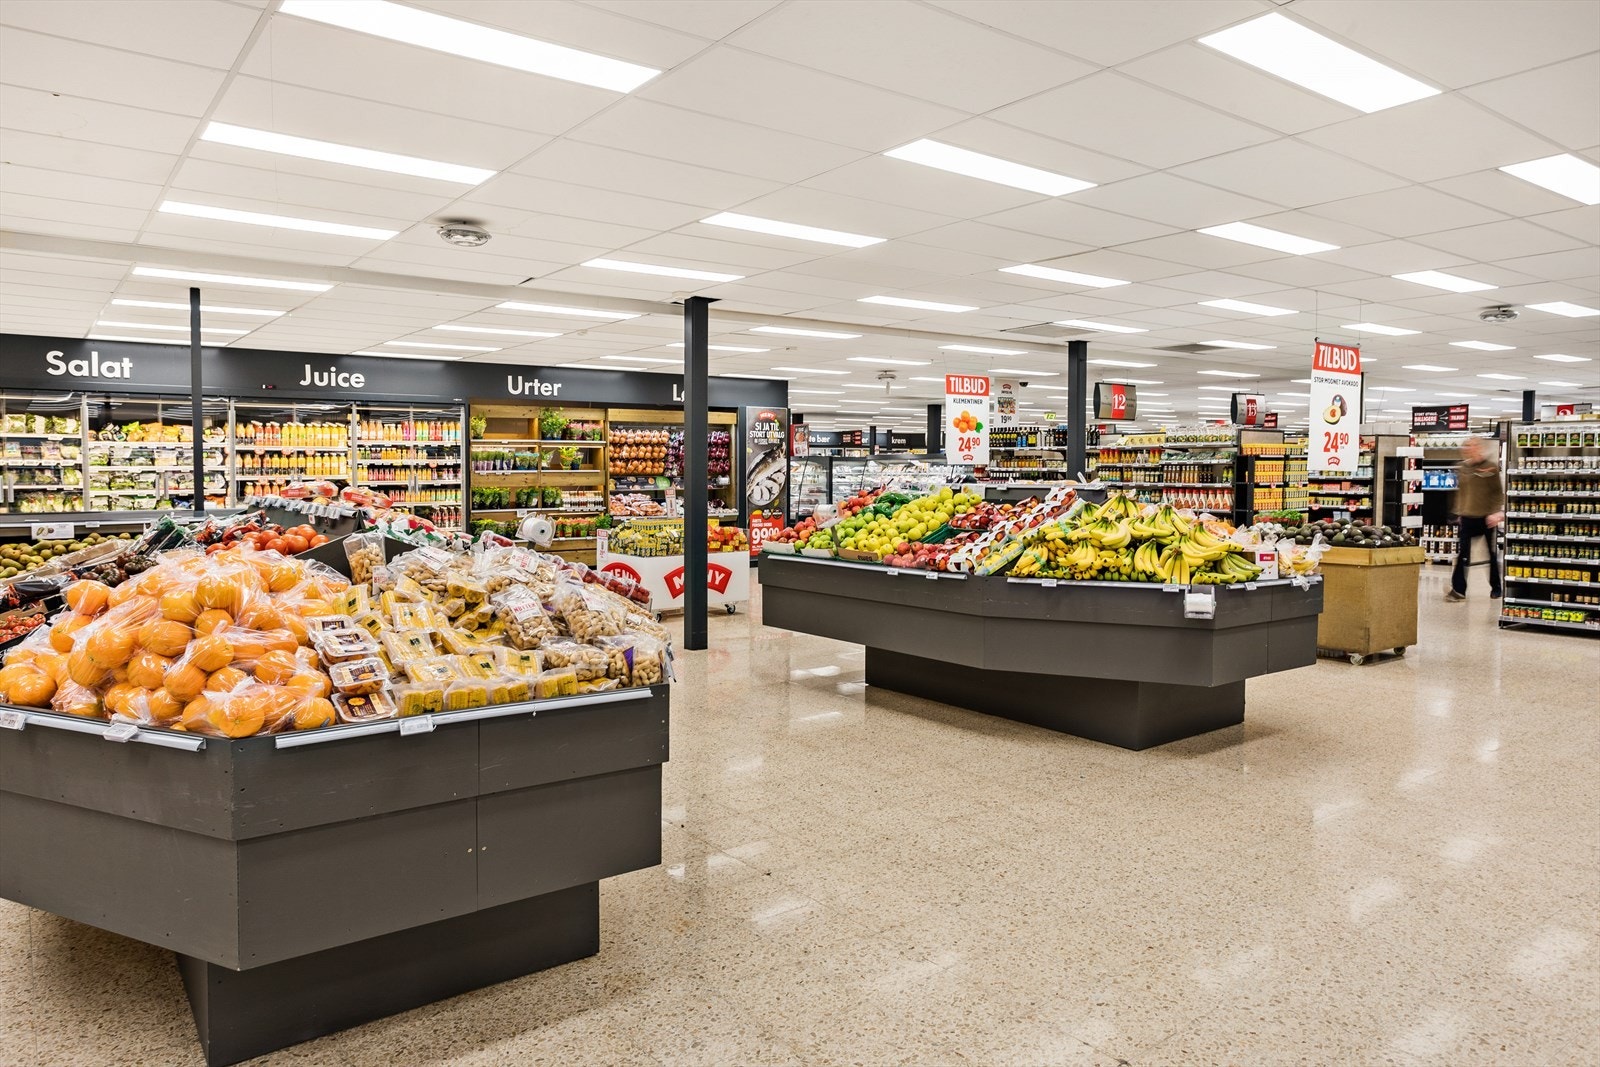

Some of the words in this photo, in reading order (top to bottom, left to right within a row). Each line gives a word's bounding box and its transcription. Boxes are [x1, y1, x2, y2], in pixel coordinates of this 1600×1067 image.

[46, 350, 133, 378] Salat
[1319, 345, 1356, 371] TILBUD
[299, 364, 365, 388] Juice
[507, 375, 562, 396] Urter
[949, 377, 986, 394] TILBUD
[1112, 393, 1126, 410] 12
[766, 431, 785, 439] UTVALG
